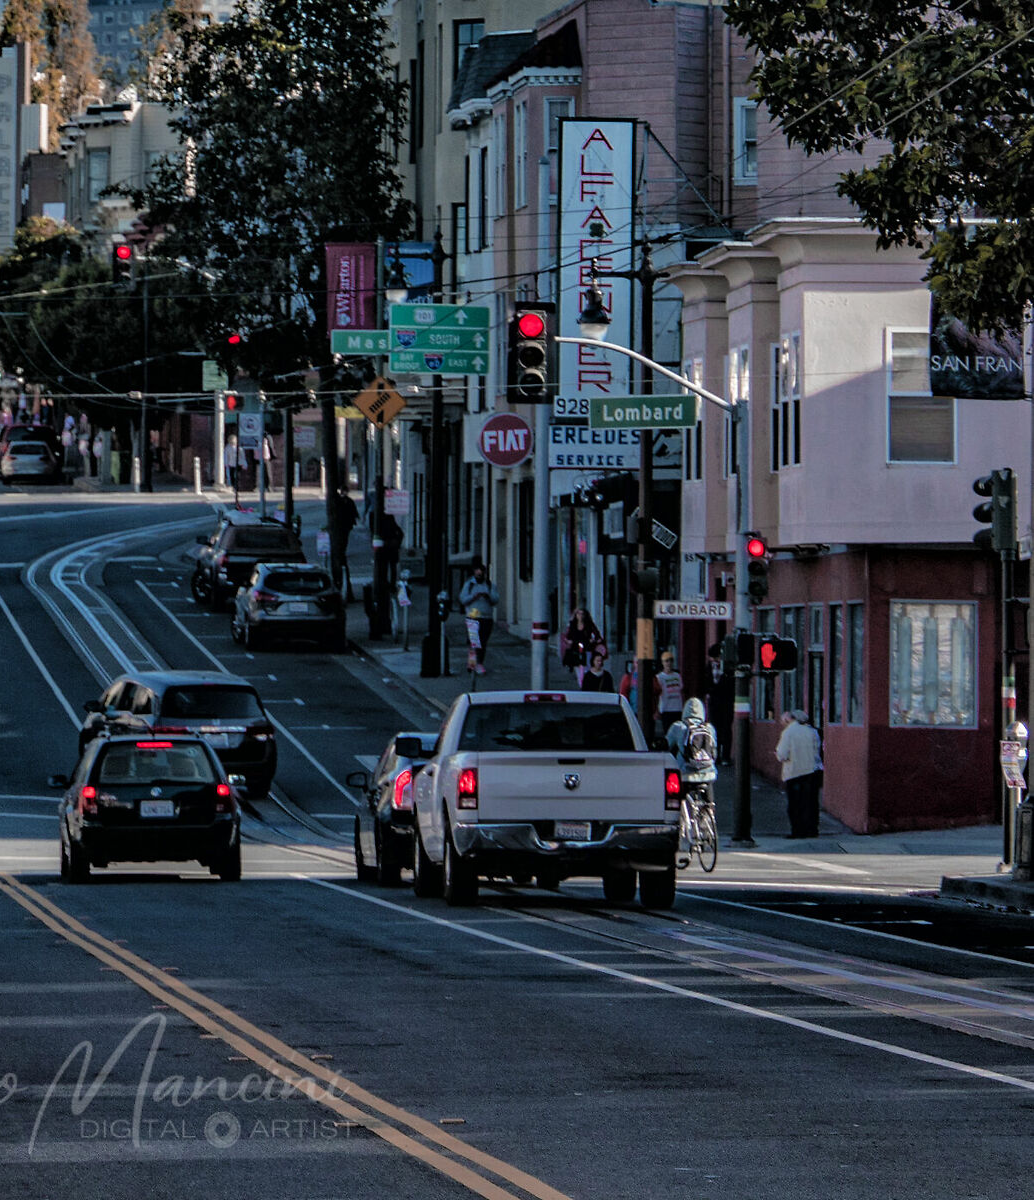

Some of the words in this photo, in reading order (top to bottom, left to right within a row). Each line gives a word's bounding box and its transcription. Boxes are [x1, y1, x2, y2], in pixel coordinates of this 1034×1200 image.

[580, 127, 614, 229] ALFA
[577, 239, 613, 393] CENER
[429, 333, 460, 345] SOUTH
[448, 359, 467, 367] EAST
[931, 355, 970, 371] SAN
[975, 355, 1023, 372] FRAN
[602, 403, 683, 422] Lombard
[483, 429, 528, 452] FIAT
[551, 426, 641, 445] ERCEDES
[556, 454, 624, 466] SERVICE
[659, 604, 727, 616] LOMBARD
